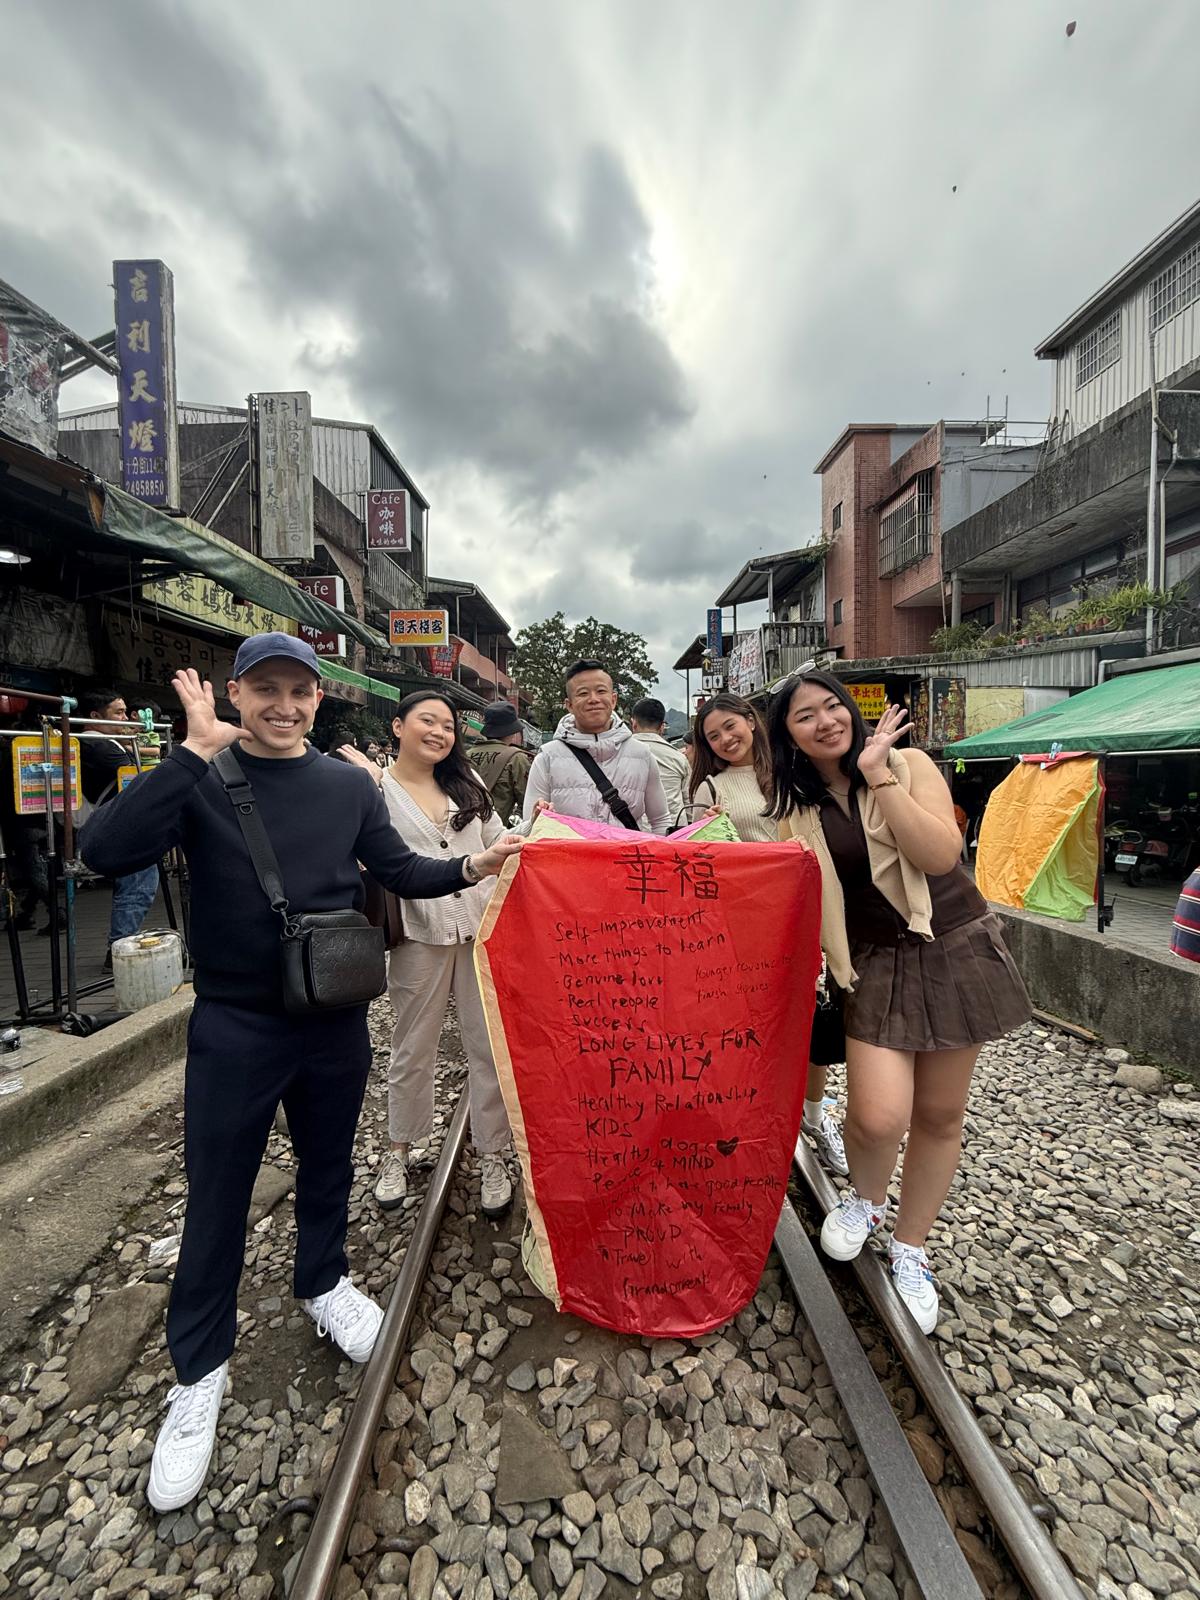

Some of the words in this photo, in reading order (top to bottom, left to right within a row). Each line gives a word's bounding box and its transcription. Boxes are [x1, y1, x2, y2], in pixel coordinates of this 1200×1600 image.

[371, 493, 401, 505] Cafe
[379, 506, 395, 536] 咖啡
[299, 581, 329, 596] afe
[847, 686, 883, 699] 車出租
[613, 845, 719, 905] 幸福
[559, 951, 598, 967] More
[604, 946, 648, 966] things
[656, 942, 671, 956] to
[681, 933, 725, 953] learn
[563, 974, 625, 990] Genuine
[567, 992, 600, 1009] Real
[578, 1034, 636, 1055] LONG
[647, 1031, 709, 1052] LIVES
[721, 1027, 762, 1051] FOR
[609, 1051, 712, 1088] FAMILY
[577, 1091, 645, 1122] Healthy
[655, 1085, 758, 1116] Relationship
[586, 1117, 633, 1139] KIDS
[673, 1156, 715, 1172] MIND
[624, 1224, 682, 1248] PROUD
